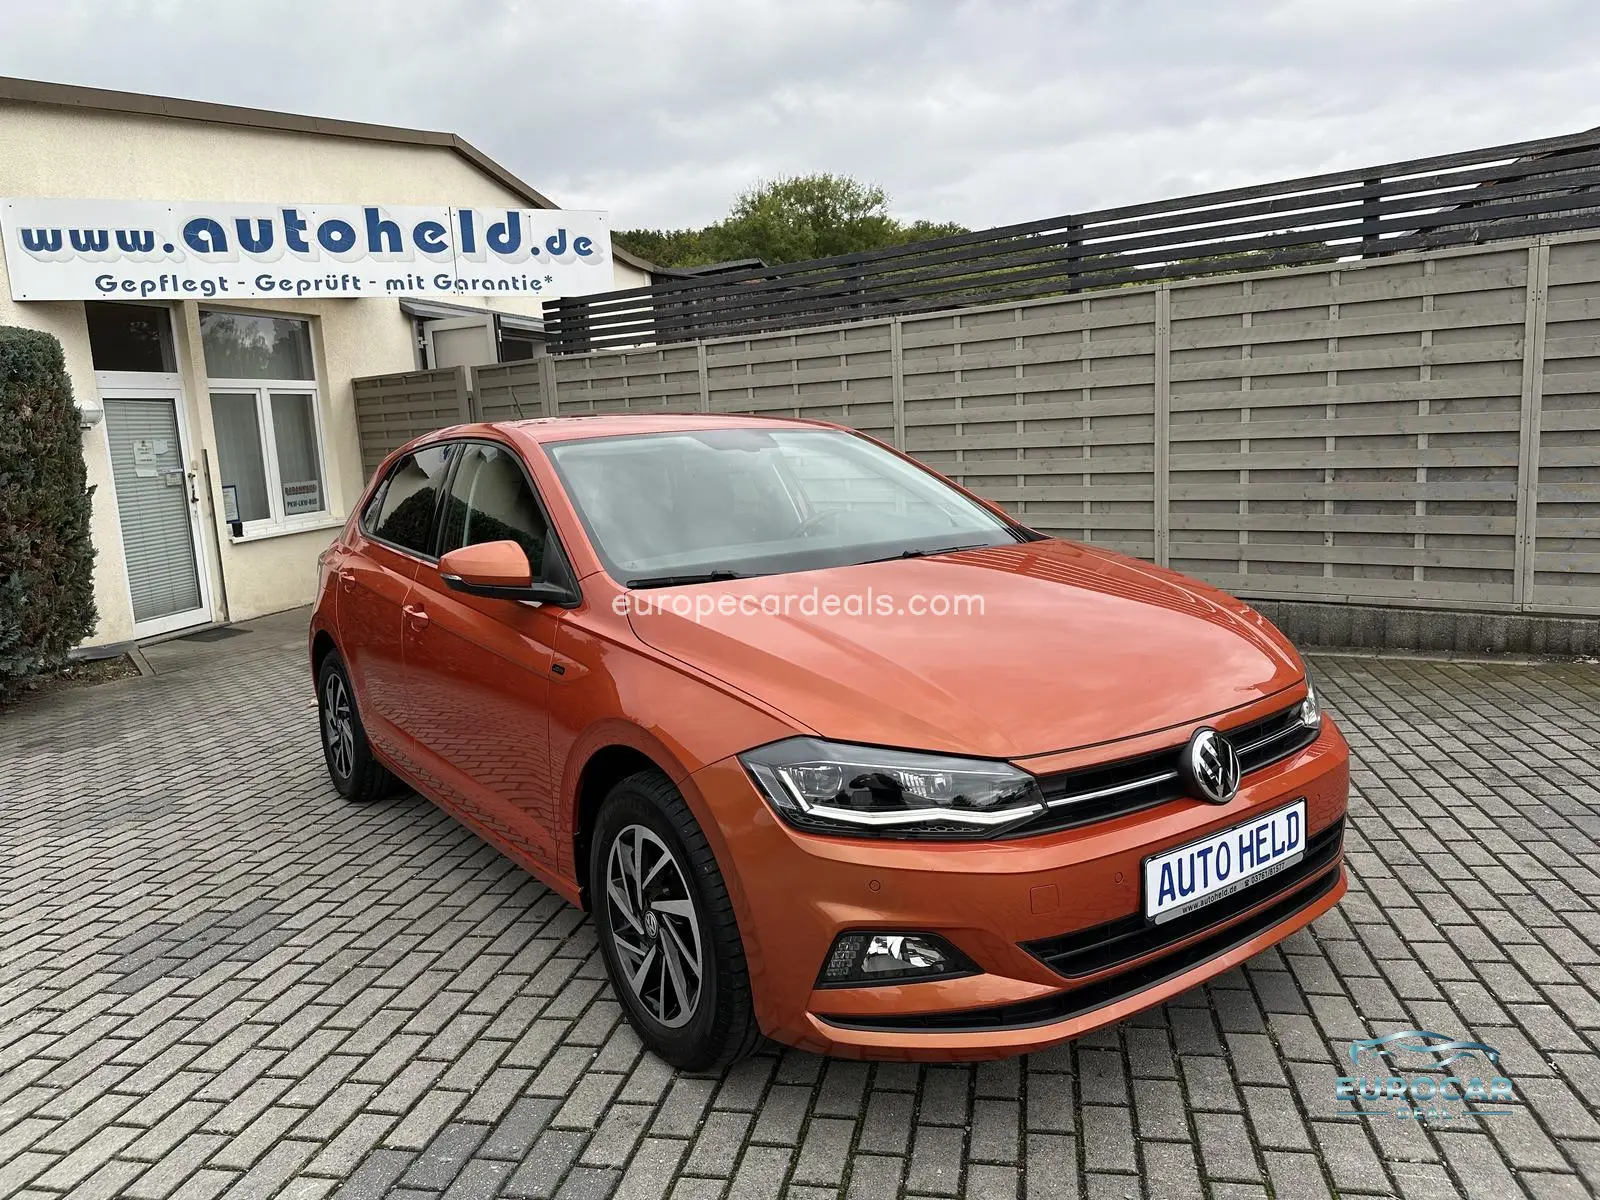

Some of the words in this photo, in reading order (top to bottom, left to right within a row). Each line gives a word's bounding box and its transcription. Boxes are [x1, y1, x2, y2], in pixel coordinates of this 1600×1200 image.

[20, 208, 594, 257] www.autoheld.de
[95, 274, 229, 297] Gepflegt
[255, 273, 361, 296] Geprüft
[386, 273, 425, 291] mit
[1158, 841, 1231, 906] AUTO
[1238, 810, 1300, 873] HELD
[1182, 885, 1237, 913] www.autoheld.de
